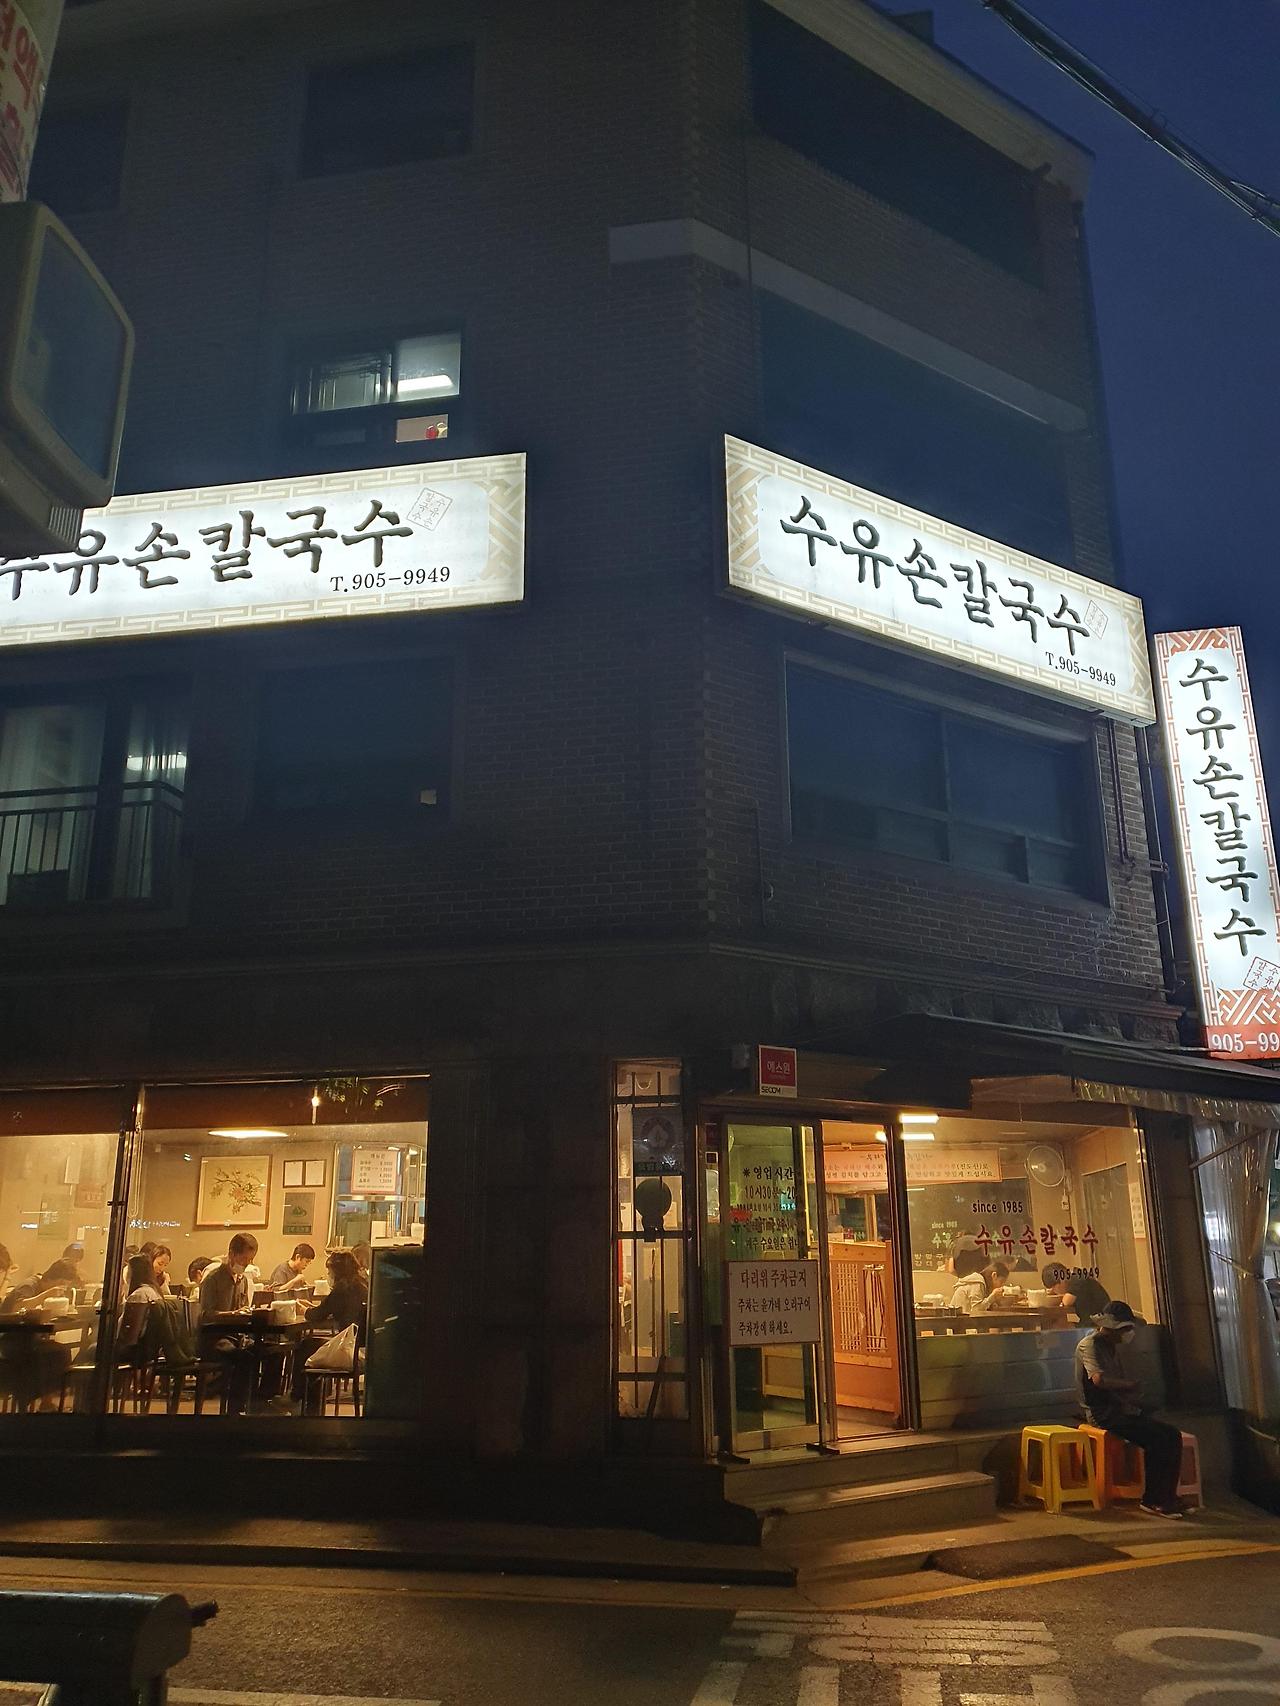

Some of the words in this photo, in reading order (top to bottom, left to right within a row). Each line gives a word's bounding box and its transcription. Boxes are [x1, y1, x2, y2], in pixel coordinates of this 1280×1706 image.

[330, 566, 451, 594] T.905-9949
[780, 495, 1090, 656] 수유손칼국수
[1045, 650, 1117, 687] T.905-9949
[1179, 658, 1267, 957] 수유손칼국수
[753, 1165, 772, 1180] 영업
[775, 1166, 795, 1181] 시간
[972, 1200, 997, 1213] since
[1002, 1201, 1023, 1214] 1985
[974, 1224, 1099, 1256] 수유손칼국수
[770, 1269, 807, 1288] 주차금지
[1053, 1267, 1100, 1280] 905-9949
[738, 1297, 759, 1312] 주차는
